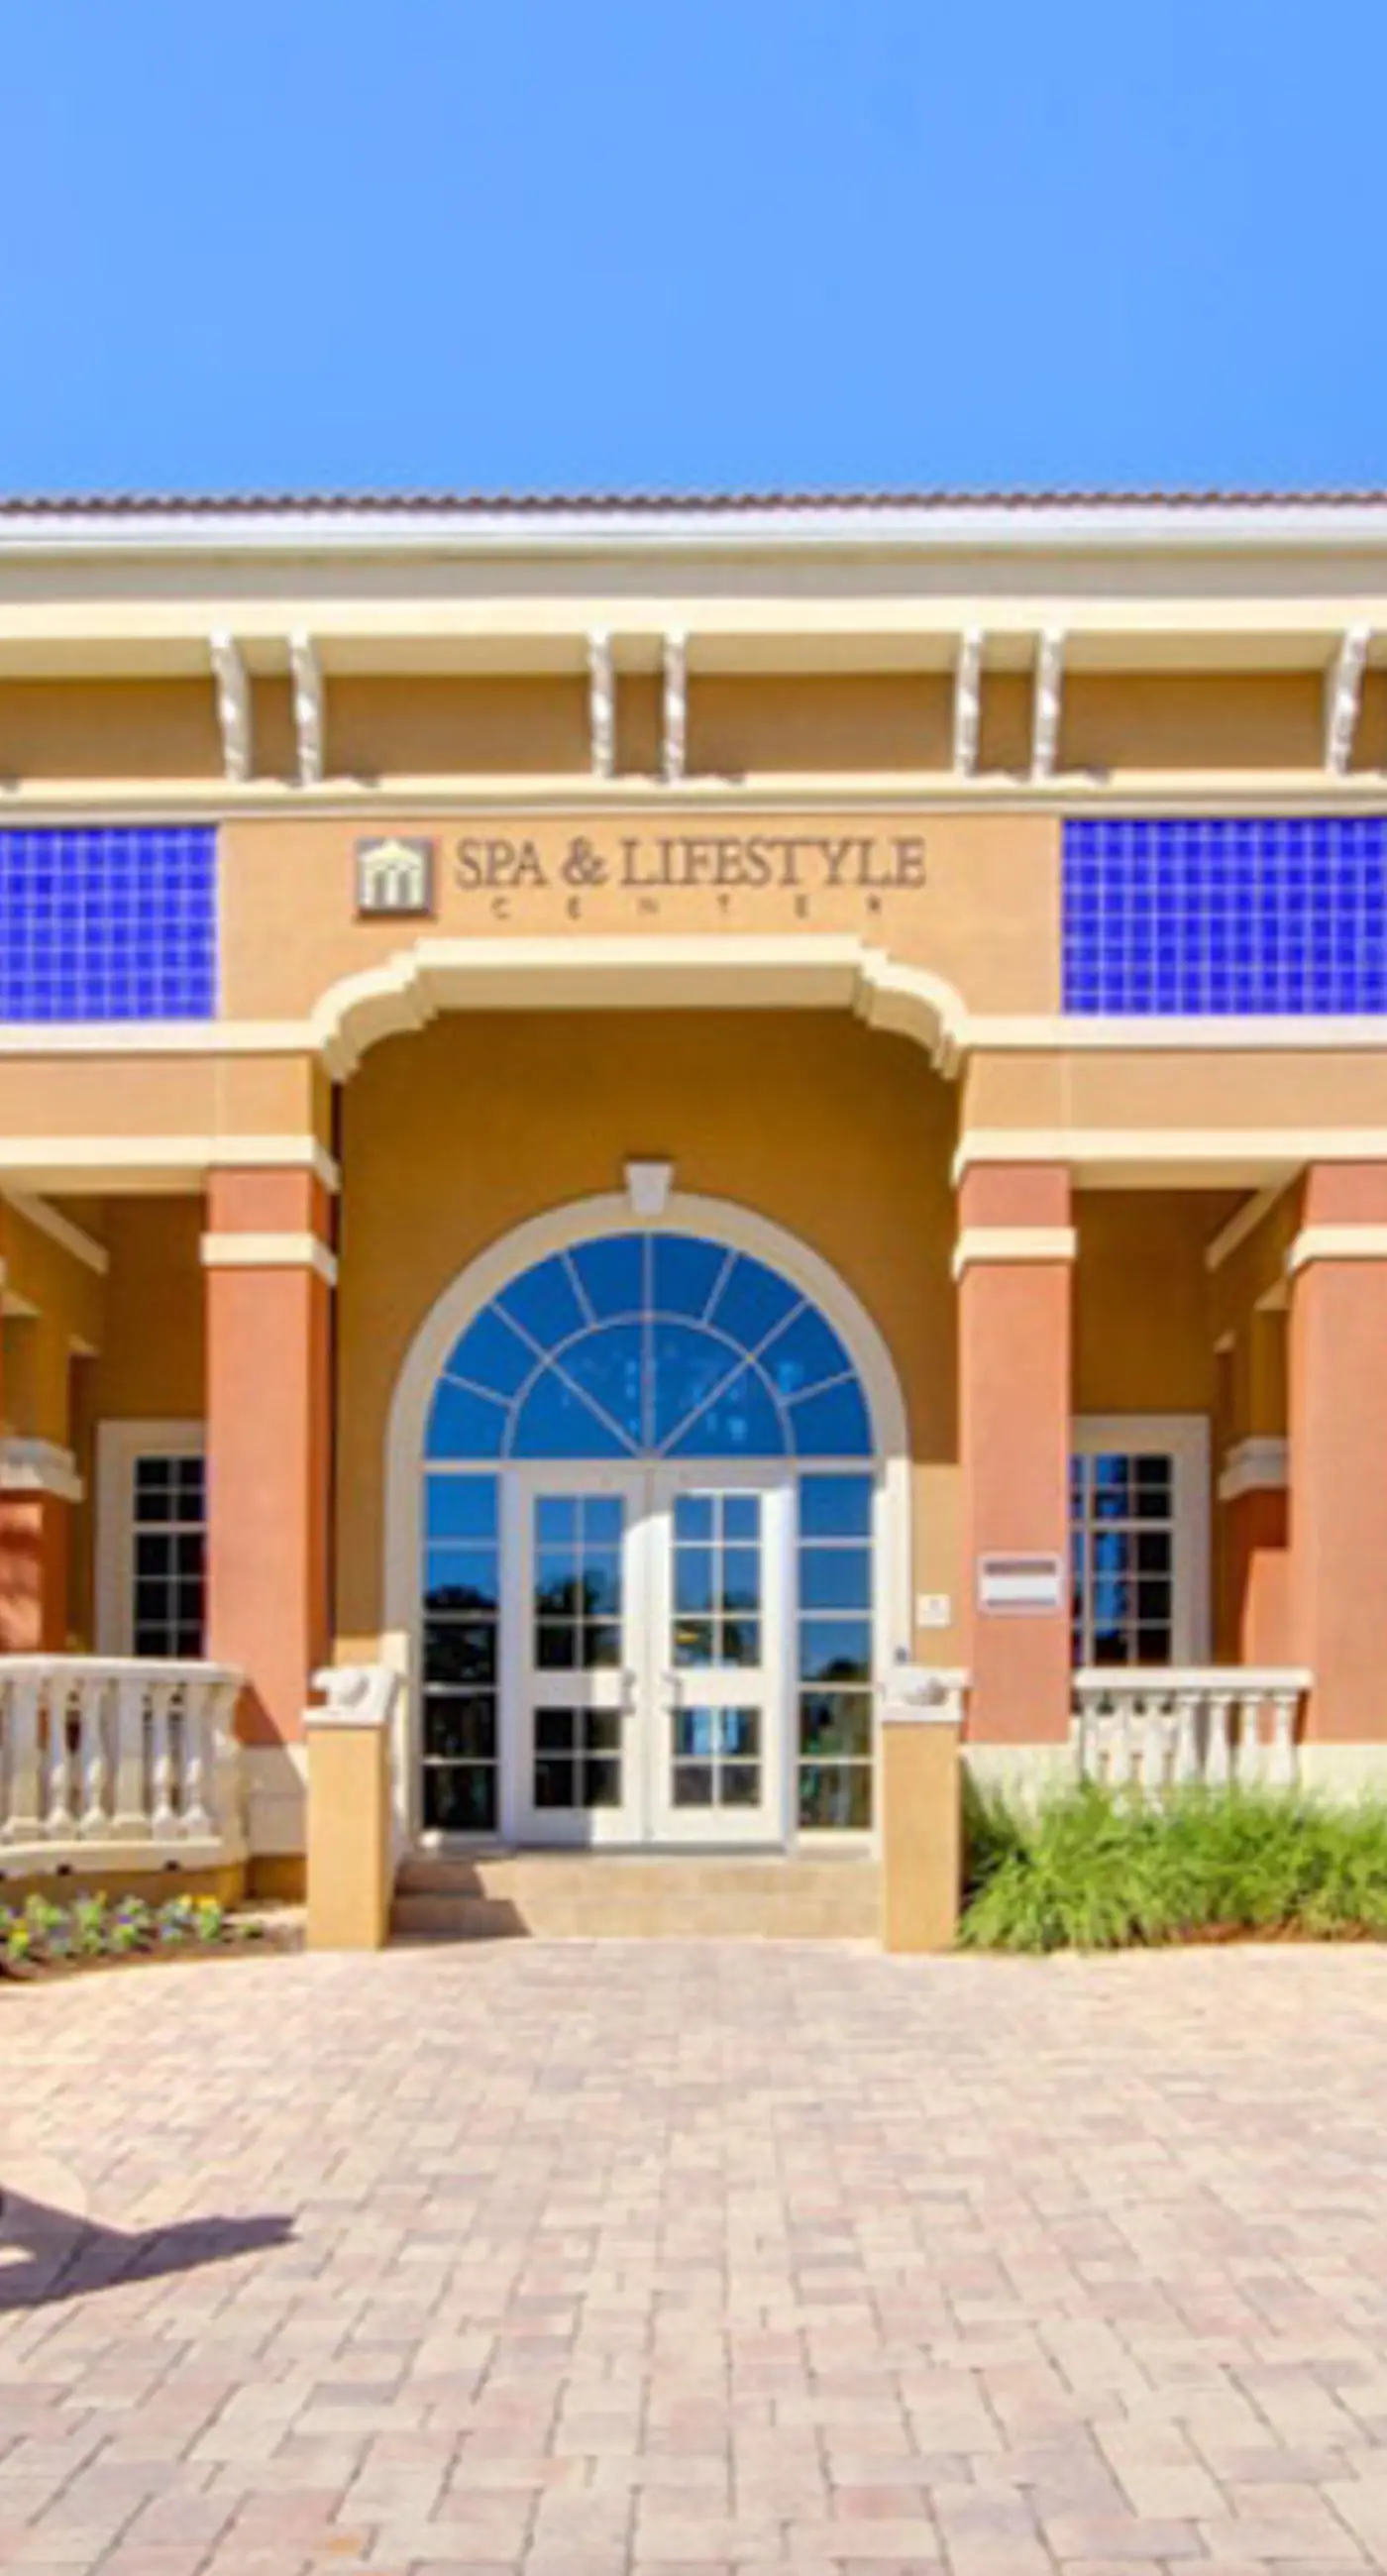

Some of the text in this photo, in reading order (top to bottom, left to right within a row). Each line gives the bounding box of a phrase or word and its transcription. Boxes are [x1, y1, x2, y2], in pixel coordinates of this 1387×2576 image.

[456, 836, 927, 889] SPA & LIFESTYLE
